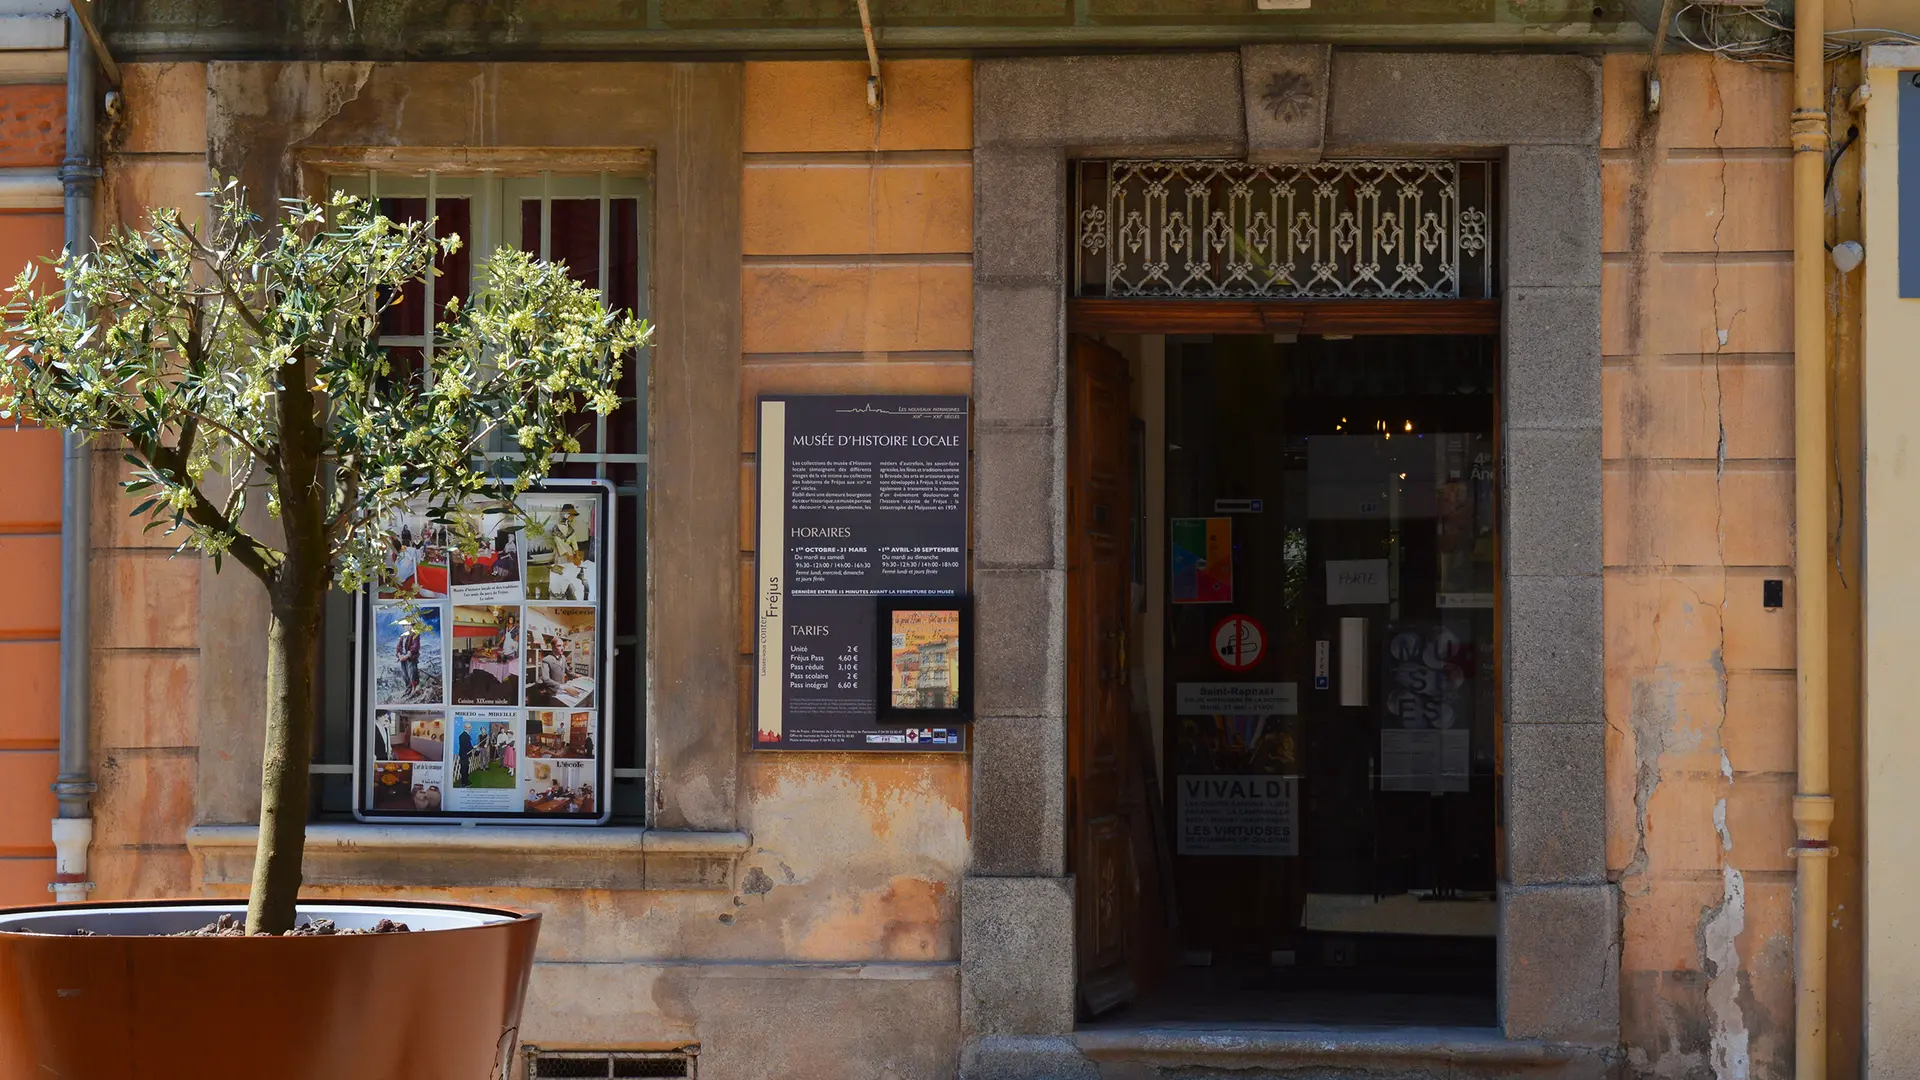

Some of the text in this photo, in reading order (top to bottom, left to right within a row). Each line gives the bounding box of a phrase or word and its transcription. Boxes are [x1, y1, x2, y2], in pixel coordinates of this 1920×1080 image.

[793, 433, 959, 447] MUSÉE D'HISTOIRE LOCALE
[791, 527, 850, 538] HORAIRES
[766, 577, 781, 617] Fréjus
[791, 625, 829, 636] TARIFS
[1200, 687, 1274, 697] Saint-Raphaël
[1185, 780, 1290, 798] VIVALDI
[1186, 826, 1290, 835] LES VIRTUOSES
